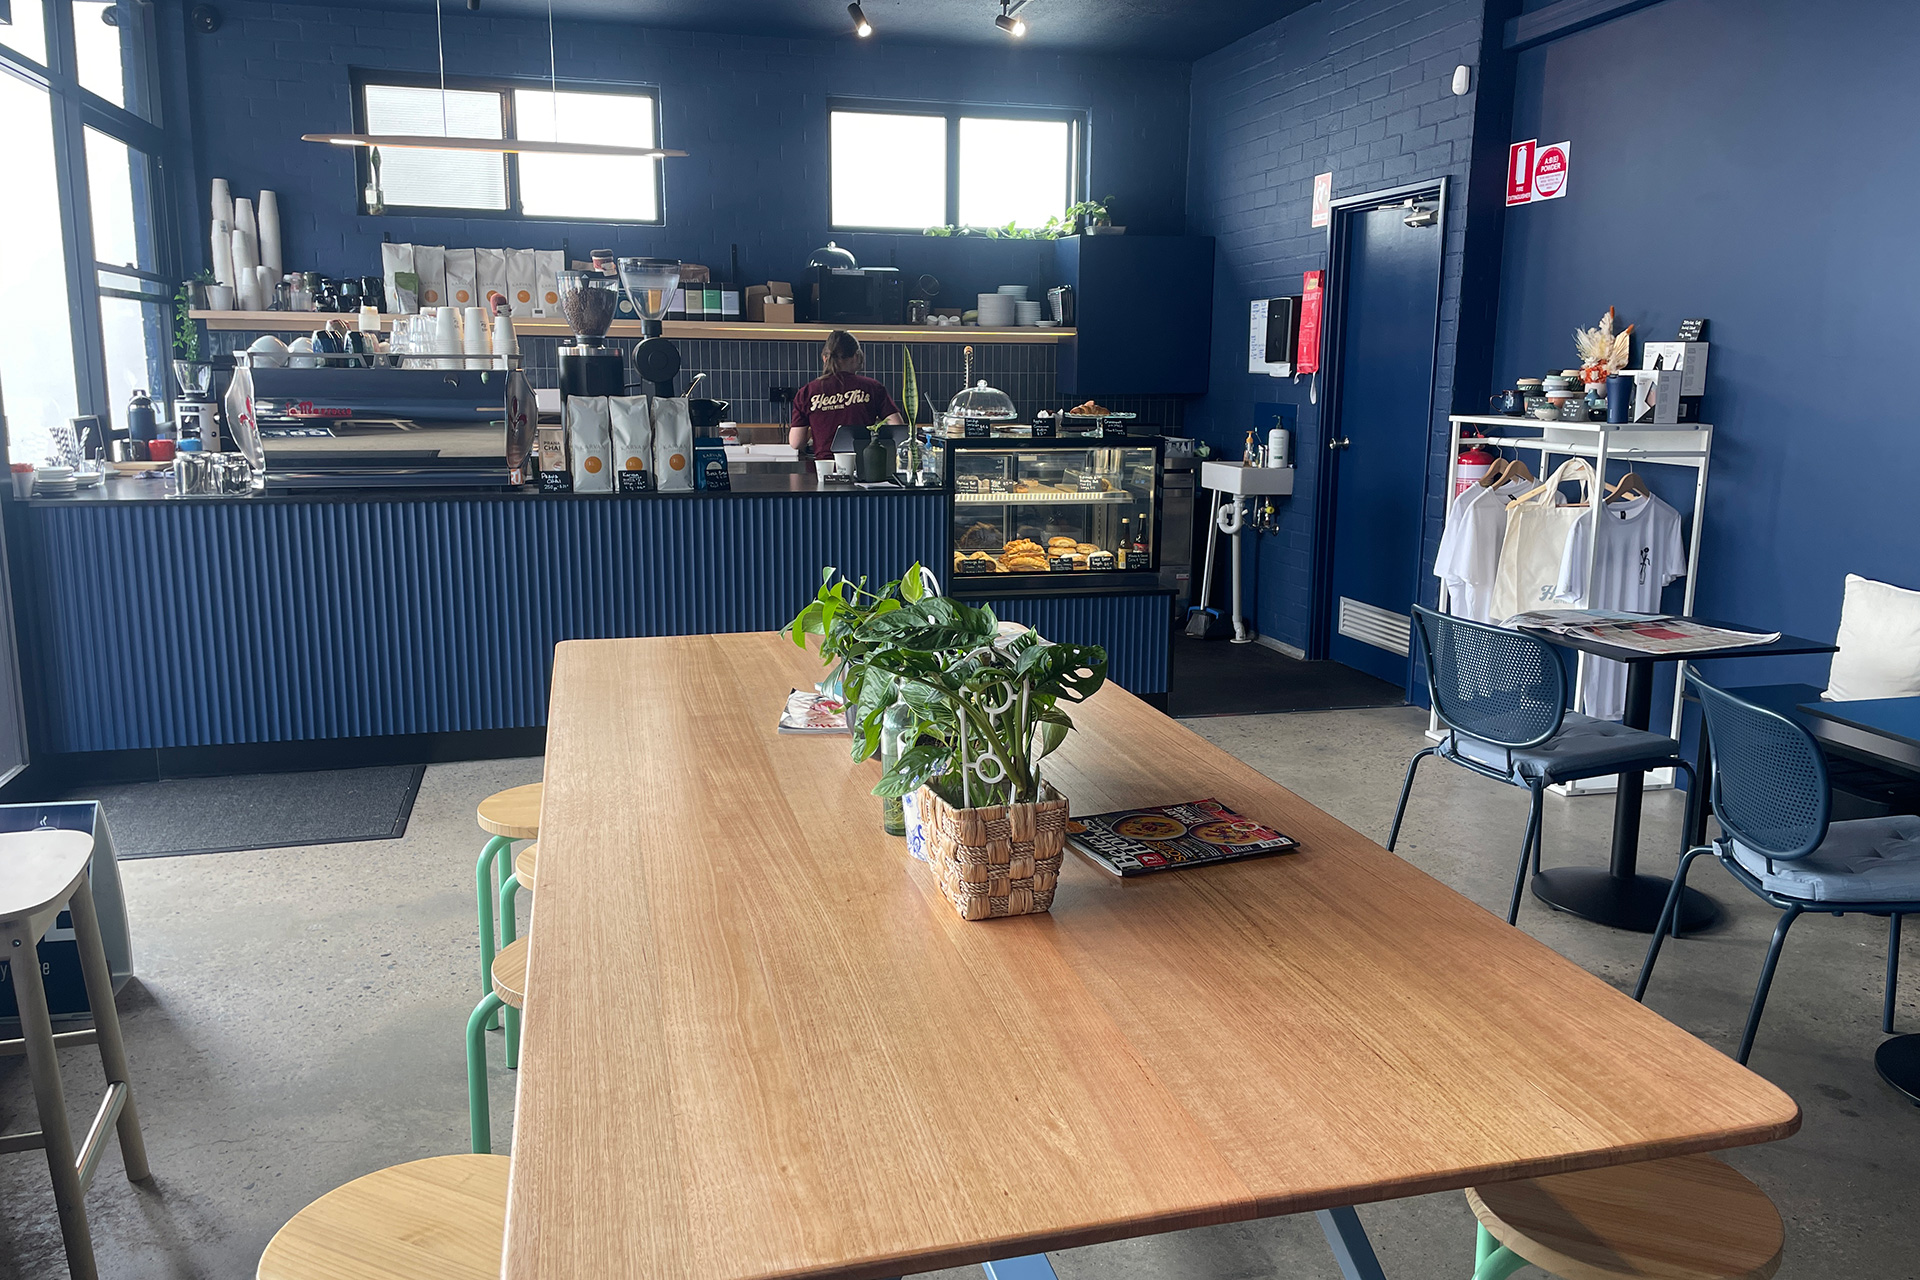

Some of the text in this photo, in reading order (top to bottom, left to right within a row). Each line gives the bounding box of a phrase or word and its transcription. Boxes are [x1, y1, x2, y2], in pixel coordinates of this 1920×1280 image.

[1540, 163, 1561, 173] POWDER
[810, 389, 870, 411] Hear This
[1078, 819, 1155, 856] Homes
[1080, 834, 1143, 868] Better
